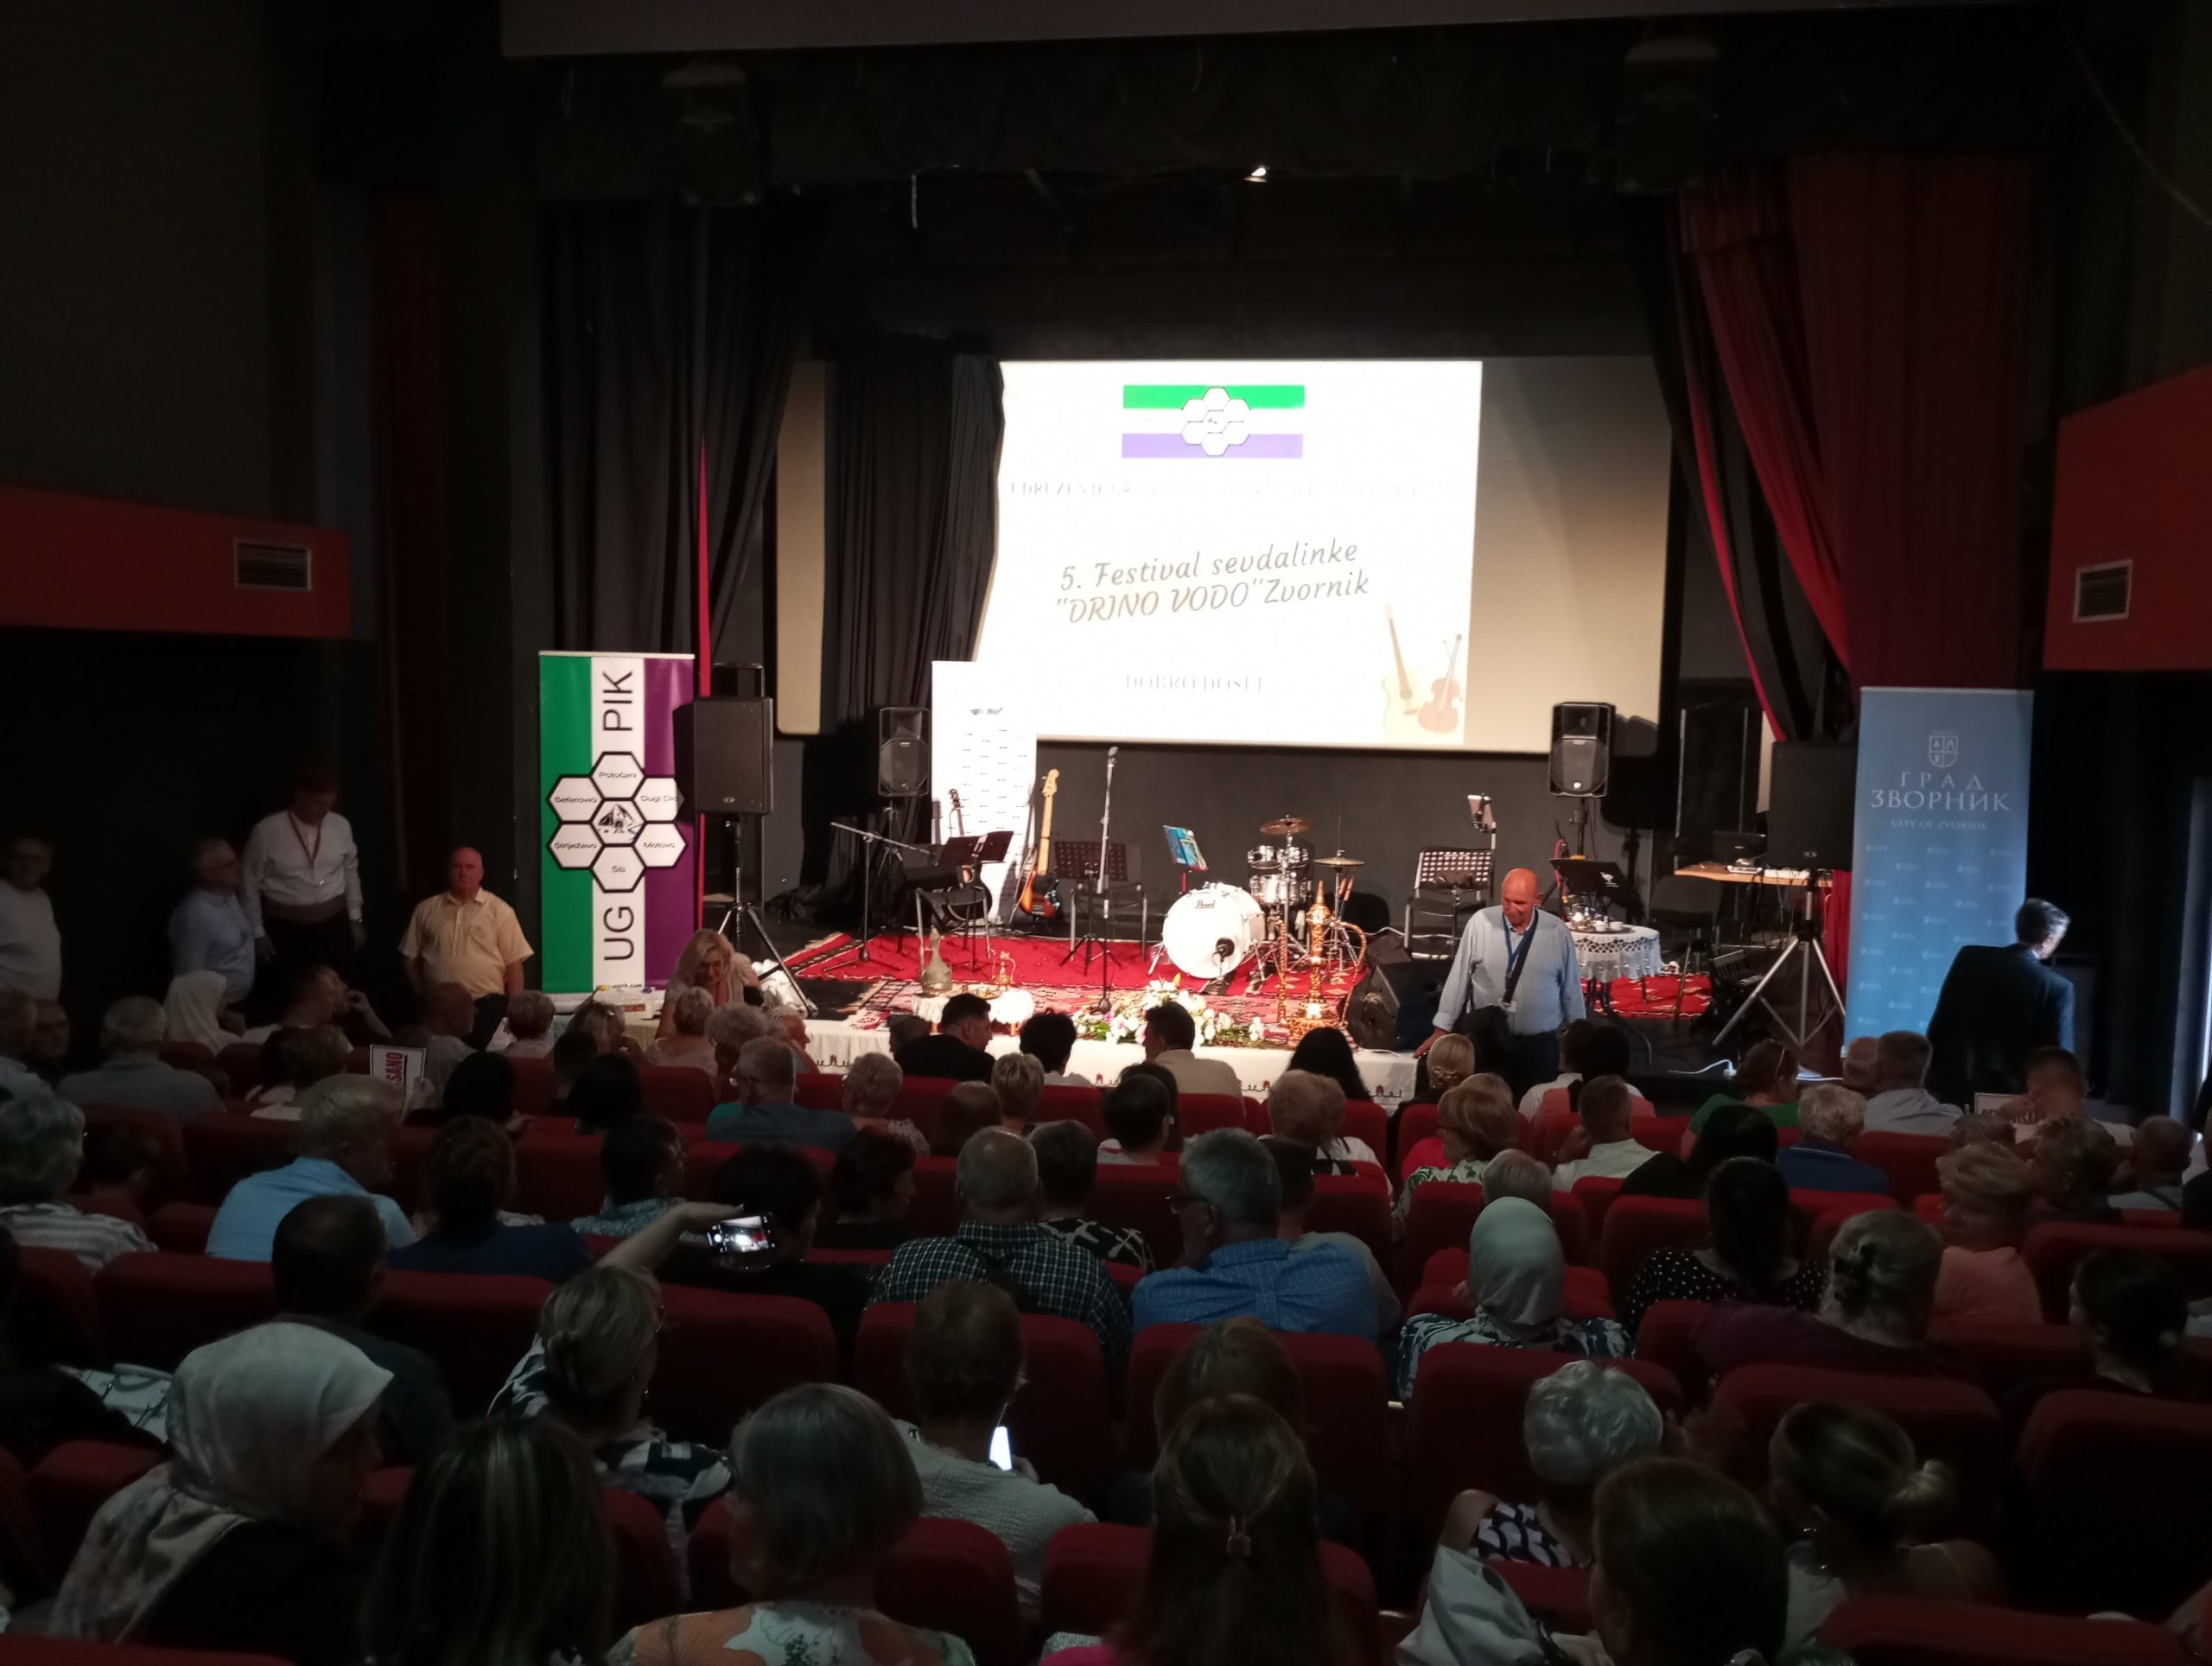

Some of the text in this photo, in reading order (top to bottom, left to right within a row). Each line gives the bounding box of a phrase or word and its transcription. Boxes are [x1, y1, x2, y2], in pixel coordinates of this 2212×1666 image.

[1060, 537, 1357, 591] 5. Festival sevdalinke
[603, 670, 633, 733] PIK
[1871, 789, 2011, 811] ЗВОРНИК
[1900, 771, 1984, 792] ГРАД
[1891, 817, 1916, 828] CITY
[1919, 819, 1933, 829] OF
[603, 904, 634, 962] UG
